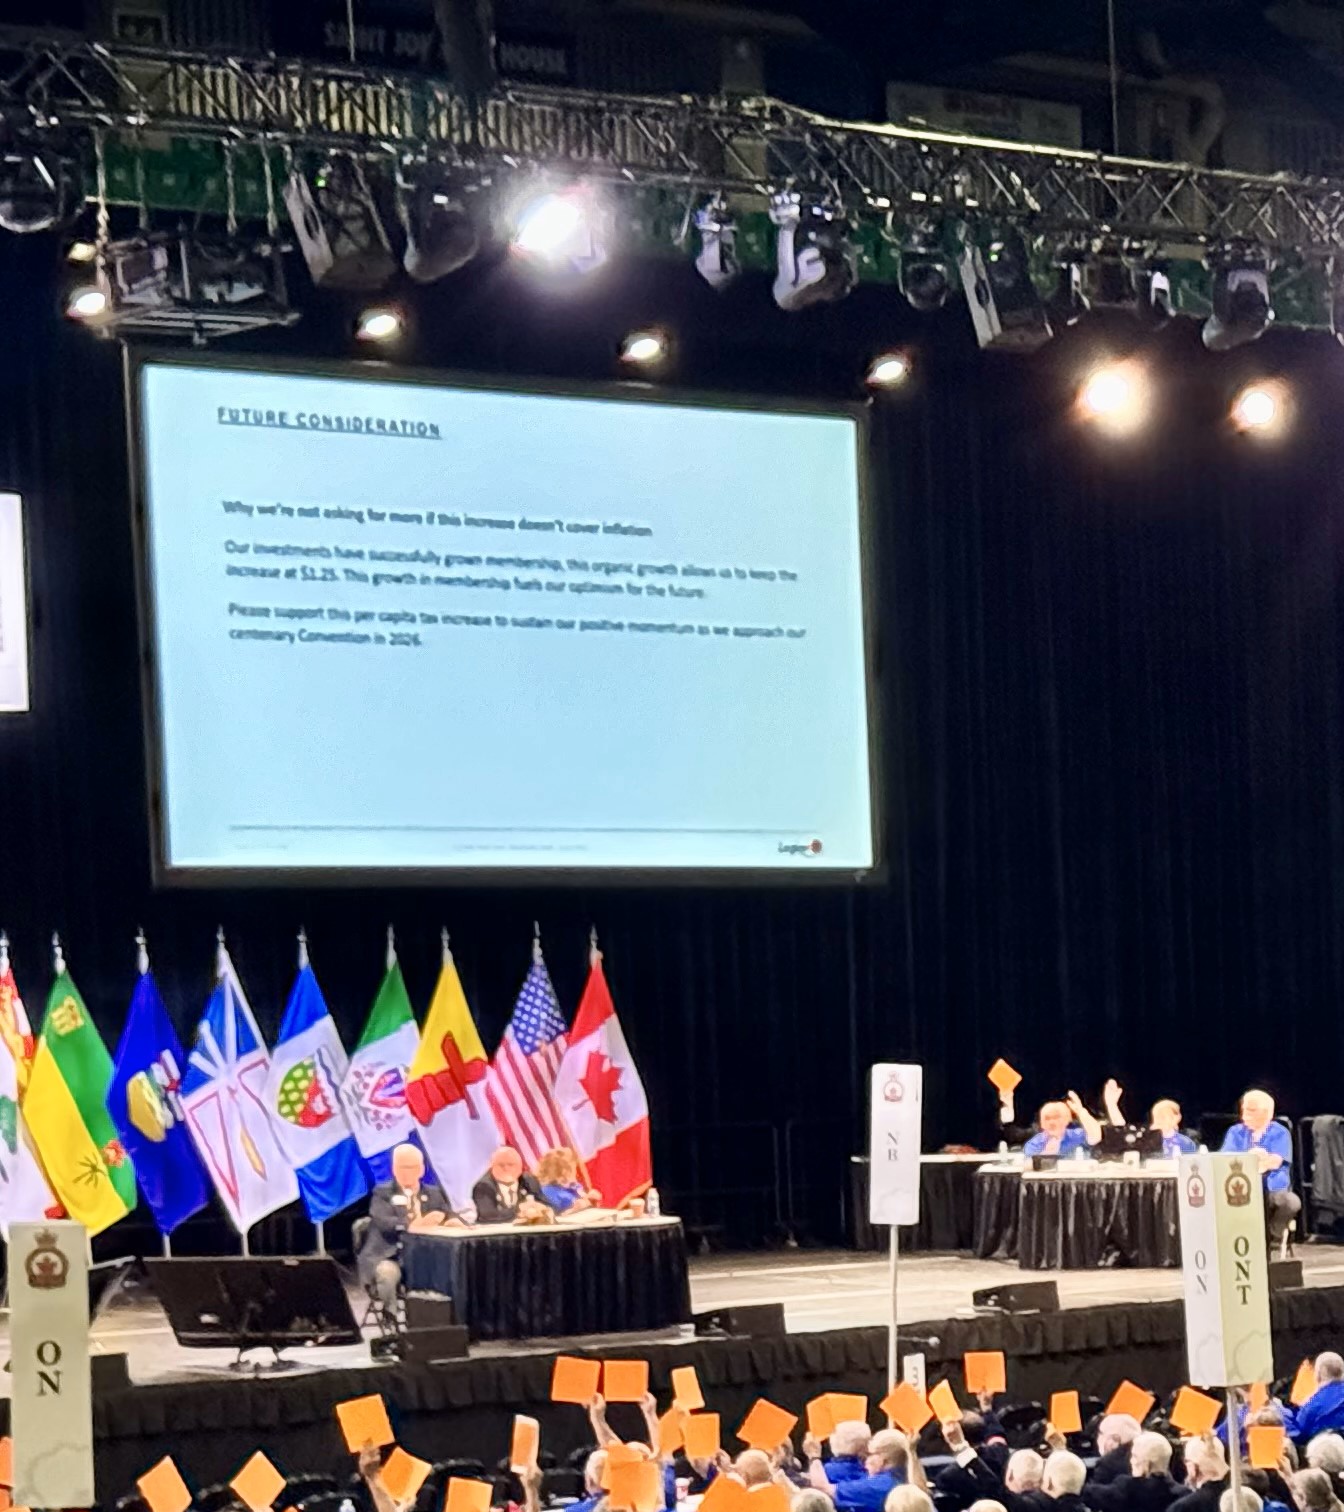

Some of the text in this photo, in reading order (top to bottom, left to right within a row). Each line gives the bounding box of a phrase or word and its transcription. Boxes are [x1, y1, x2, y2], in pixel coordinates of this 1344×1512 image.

[217, 406, 440, 437] FUTURE CONSIDERATION
[324, 506, 364, 523] asking
[464, 514, 515, 530] increase
[224, 539, 249, 553] Our
[368, 549, 440, 566] successfully
[637, 563, 678, 578] growth
[226, 564, 281, 578] increase
[372, 572, 416, 587] growth
[434, 575, 511, 591] membership
[228, 602, 270, 618] Please
[274, 607, 324, 621] support
[229, 628, 295, 645] centenary
[298, 627, 371, 644] Convention
[1194, 1250, 1208, 1295] ON
[1233, 1236, 1252, 1305] ONT
[36, 1340, 63, 1396] ON
